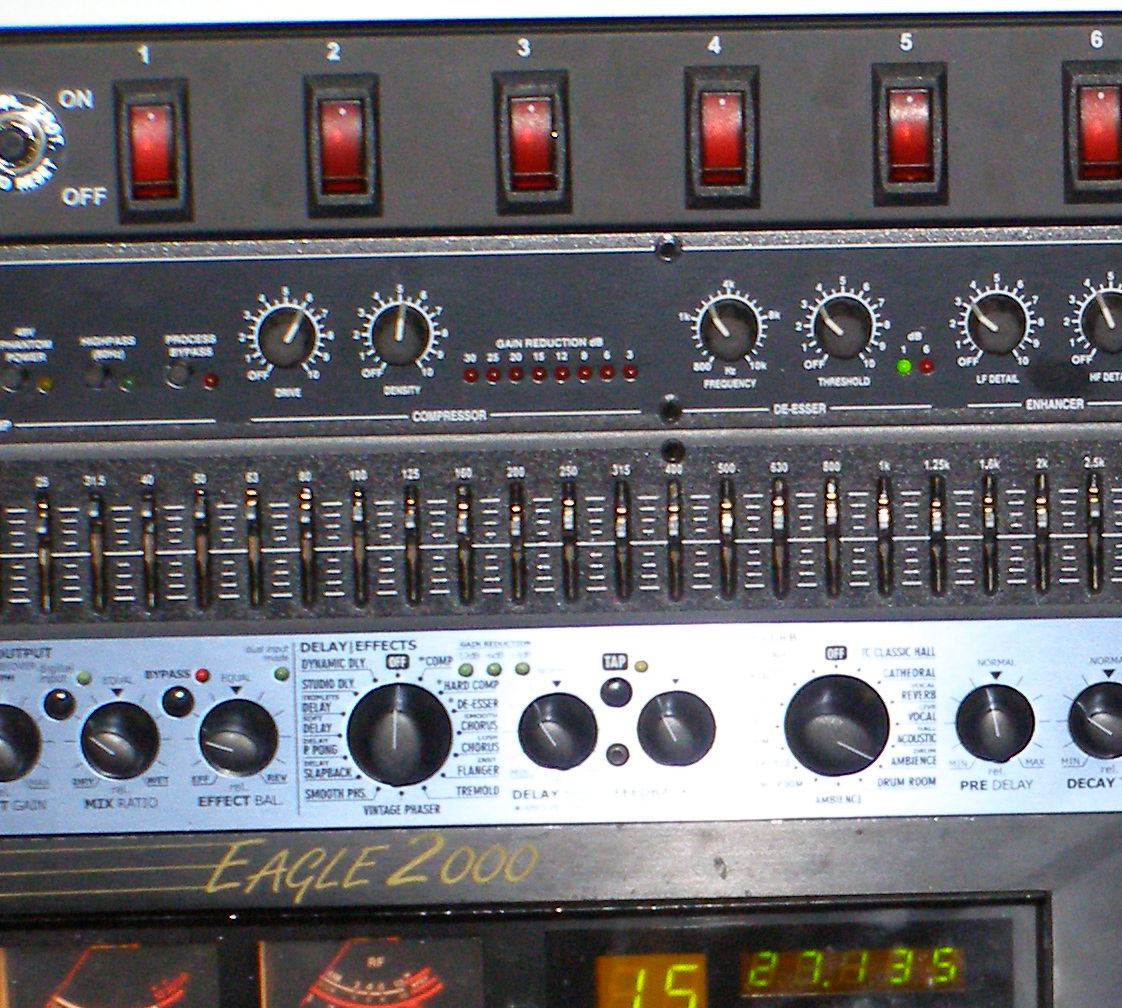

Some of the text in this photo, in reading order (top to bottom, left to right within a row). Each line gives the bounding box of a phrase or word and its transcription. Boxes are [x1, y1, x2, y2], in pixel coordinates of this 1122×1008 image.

[707, 36, 722, 54] 4
[900, 33, 914, 52] 5
[1090, 30, 1104, 49] 6
[326, 42, 341, 62] 2
[517, 38, 532, 58] 3
[137, 44, 151, 65] 1
[59, 89, 94, 110] ON
[62, 186, 107, 207] OFF
[163, 333, 218, 345] PROCESS
[907, 331, 922, 341] dB
[495, 336, 587, 349] GAIN REDUCTION
[168, 346, 214, 358] BYPASS
[463, 351, 568, 363] 30 25 20 15 12
[750, 360, 768, 371] 10k
[803, 360, 824, 370] OFF
[864, 359, 876, 369] 10
[957, 357, 978, 367] OFF
[1017, 356, 1030, 366] 10
[1071, 355, 1092, 365] OFF
[246, 369, 269, 381] OFF
[361, 367, 384, 379] OFF
[1089, 373, 1100, 382] HF
[703, 379, 757, 390] FREQUENCY
[817, 377, 871, 387] THRESHOLD
[976, 374, 1020, 385] LF DETAIL
[383, 385, 421, 396] DENSITY
[773, 403, 827, 415] DE-ESSER
[1026, 399, 1085, 411] ENHANCER
[412, 409, 488, 423] COMPRESSOR
[401, 468, 420, 480] 125
[506, 466, 526, 478] 200
[559, 465, 578, 478] 250
[612, 464, 632, 476] 315
[665, 463, 683, 475] 400
[718, 462, 737, 474] 500
[878, 460, 892, 472] 1k
[924, 460, 951, 472] 1.25k
[1035, 458, 1049, 470] 2k
[1083, 457, 1105, 469] 2.5k
[827, 648, 846, 659] OFF
[875, 647, 936, 658] CLASSIC HALL
[302, 659, 347, 669] DYNAMIC
[389, 657, 408, 667] OFF
[603, 655, 627, 669] TAP
[978, 658, 1015, 667] NORMAL
[145, 670, 191, 681] BYPASS
[884, 668, 936, 678] CATHEDRAL
[302, 680, 335, 690] STUDIO
[444, 680, 499, 690] HARD COMP
[901, 690, 936, 700] REVERB
[302, 703, 331, 713] DELAY
[458, 699, 499, 709] DE-ESSER
[908, 712, 936, 722] VOCAL
[303, 724, 332, 733] DELAY
[461, 721, 498, 731] CHORUS
[898, 734, 937, 743] ACOUSTIC
[462, 743, 499, 752] CHORUS
[891, 756, 937, 766] AMBIENCE
[304, 768, 352, 778] SLAPBACK
[458, 766, 500, 776] FLANGER
[878, 778, 936, 788] DRUM ROOM
[960, 779, 1034, 791] PRE DELAY
[1067, 778, 1116, 789] DECAY
[306, 790, 343, 799] SMOOTH
[513, 789, 559, 800] DELAY
[84, 798, 158, 810] MIX RATIO
[198, 796, 251, 807] EFFECT
[364, 804, 440, 815] VINTAGE PHASER
[205, 833, 539, 904] EAGLE 2000
[747, 947, 961, 988] 27.135
